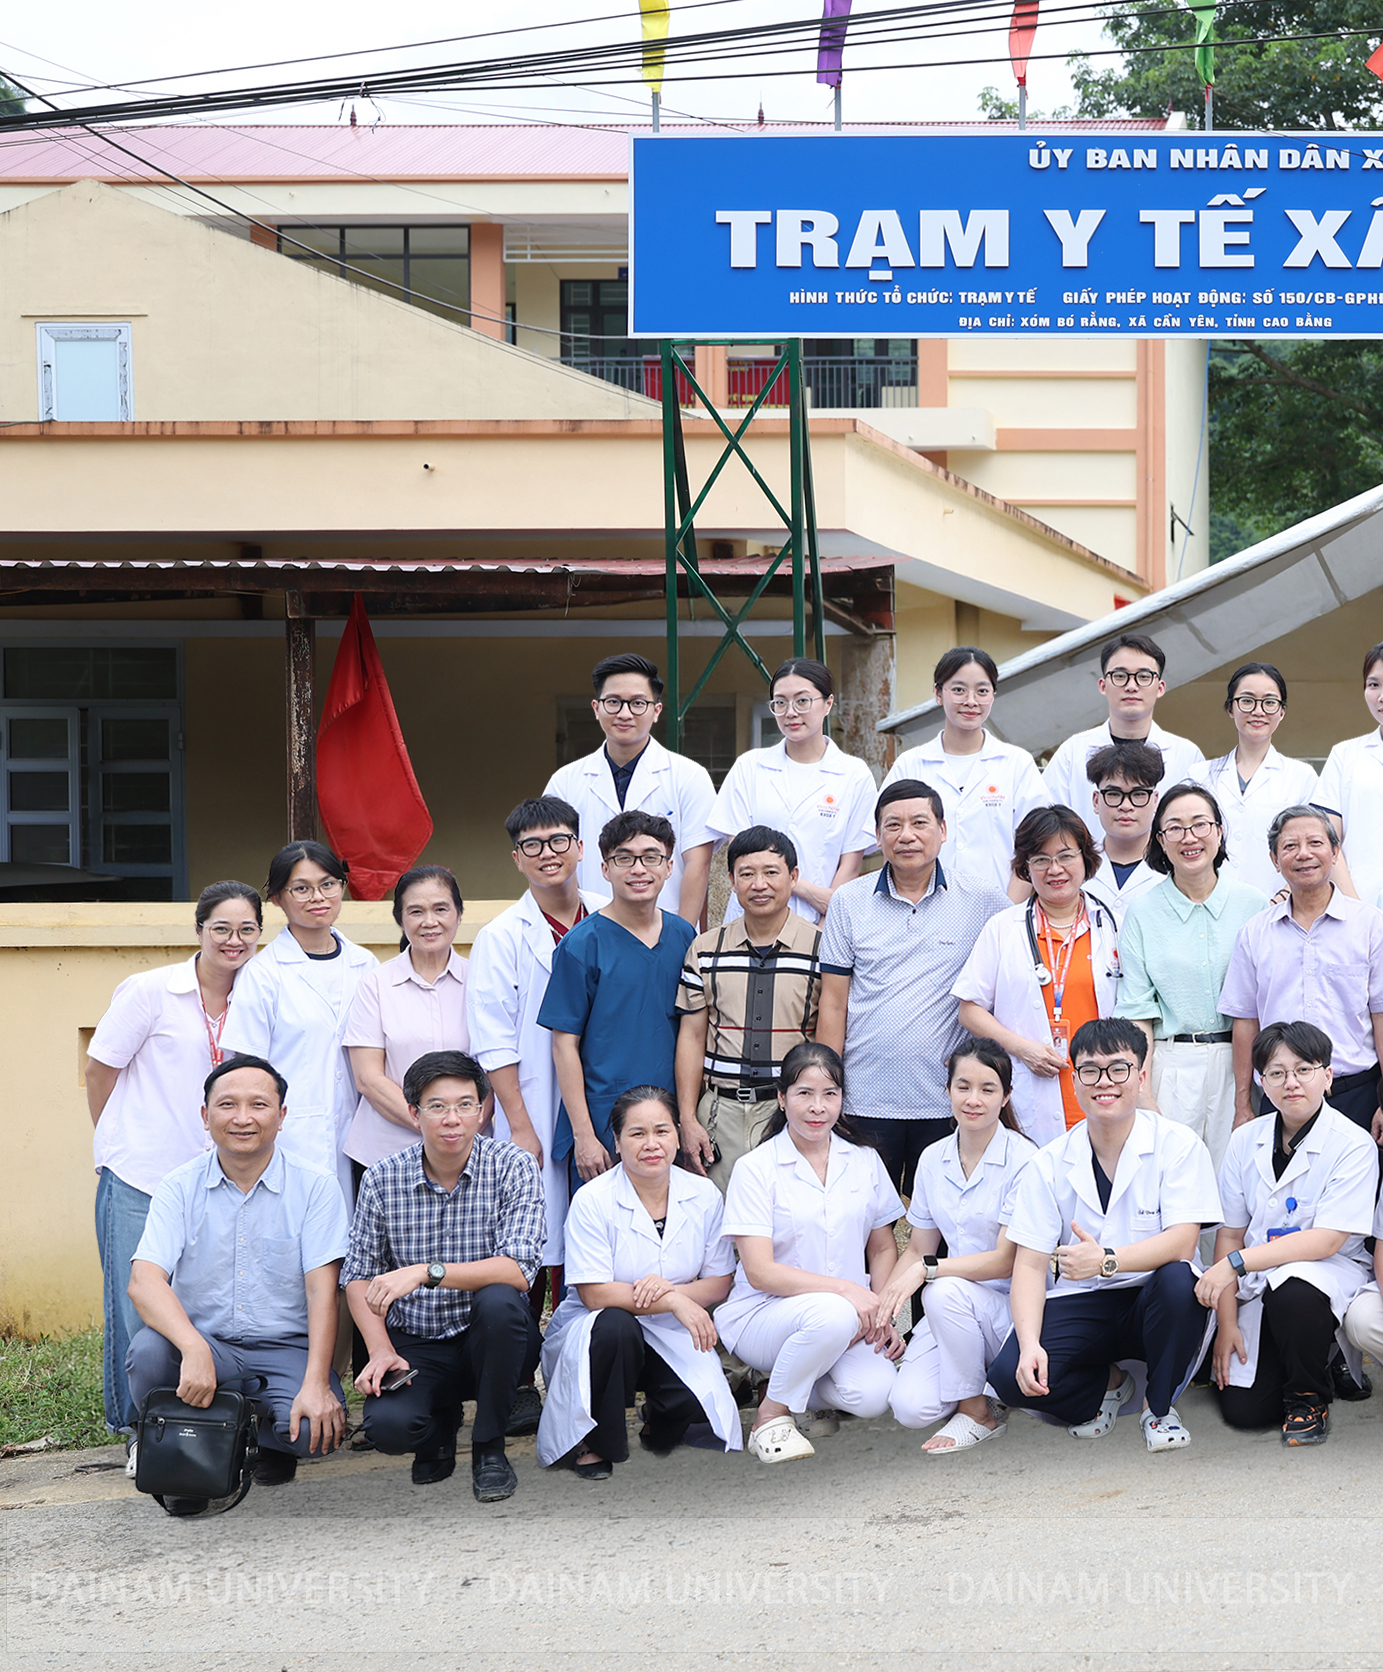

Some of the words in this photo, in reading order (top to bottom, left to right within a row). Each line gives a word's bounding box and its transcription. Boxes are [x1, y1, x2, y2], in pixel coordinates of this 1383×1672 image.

[1029, 140, 1073, 169] ỦY
[1086, 148, 1157, 169] BAN
[1170, 143, 1268, 169] NHÂN
[1279, 143, 1350, 169] DÂN
[715, 209, 1010, 281] TRẠM
[1043, 209, 1107, 268] Y
[1139, 187, 1268, 269] TẾ
[789, 288, 829, 304] HÌNH
[834, 288, 878, 304] THỨC
[882, 284, 902, 304] TỔ
[906, 287, 954, 304] CHỨC:
[958, 291, 1003, 307] TRẠM
[1004, 291, 1015, 304] Y
[1016, 287, 1038, 304] TẾ
[1062, 287, 1099, 305] GIẤY
[1105, 287, 1147, 304] PHÉP
[1152, 291, 1192, 308] HOẠT
[1197, 288, 1246, 308] ĐỘNG:
[1252, 287, 1275, 304] SỐ
[958, 316, 982, 330] ĐỊA
[988, 313, 1015, 328] CHỈ:
[1020, 313, 1051, 328] XÓM
[1057, 313, 1075, 328] BÓ
[1128, 314, 1147, 328] XÃ
[1153, 312, 1181, 328] CẦN
[1188, 314, 1219, 329] YÊN,
[1225, 313, 1256, 328] TỈNH
[1262, 316, 1289, 328] CAO
[1295, 311, 1333, 328] BẰNG
